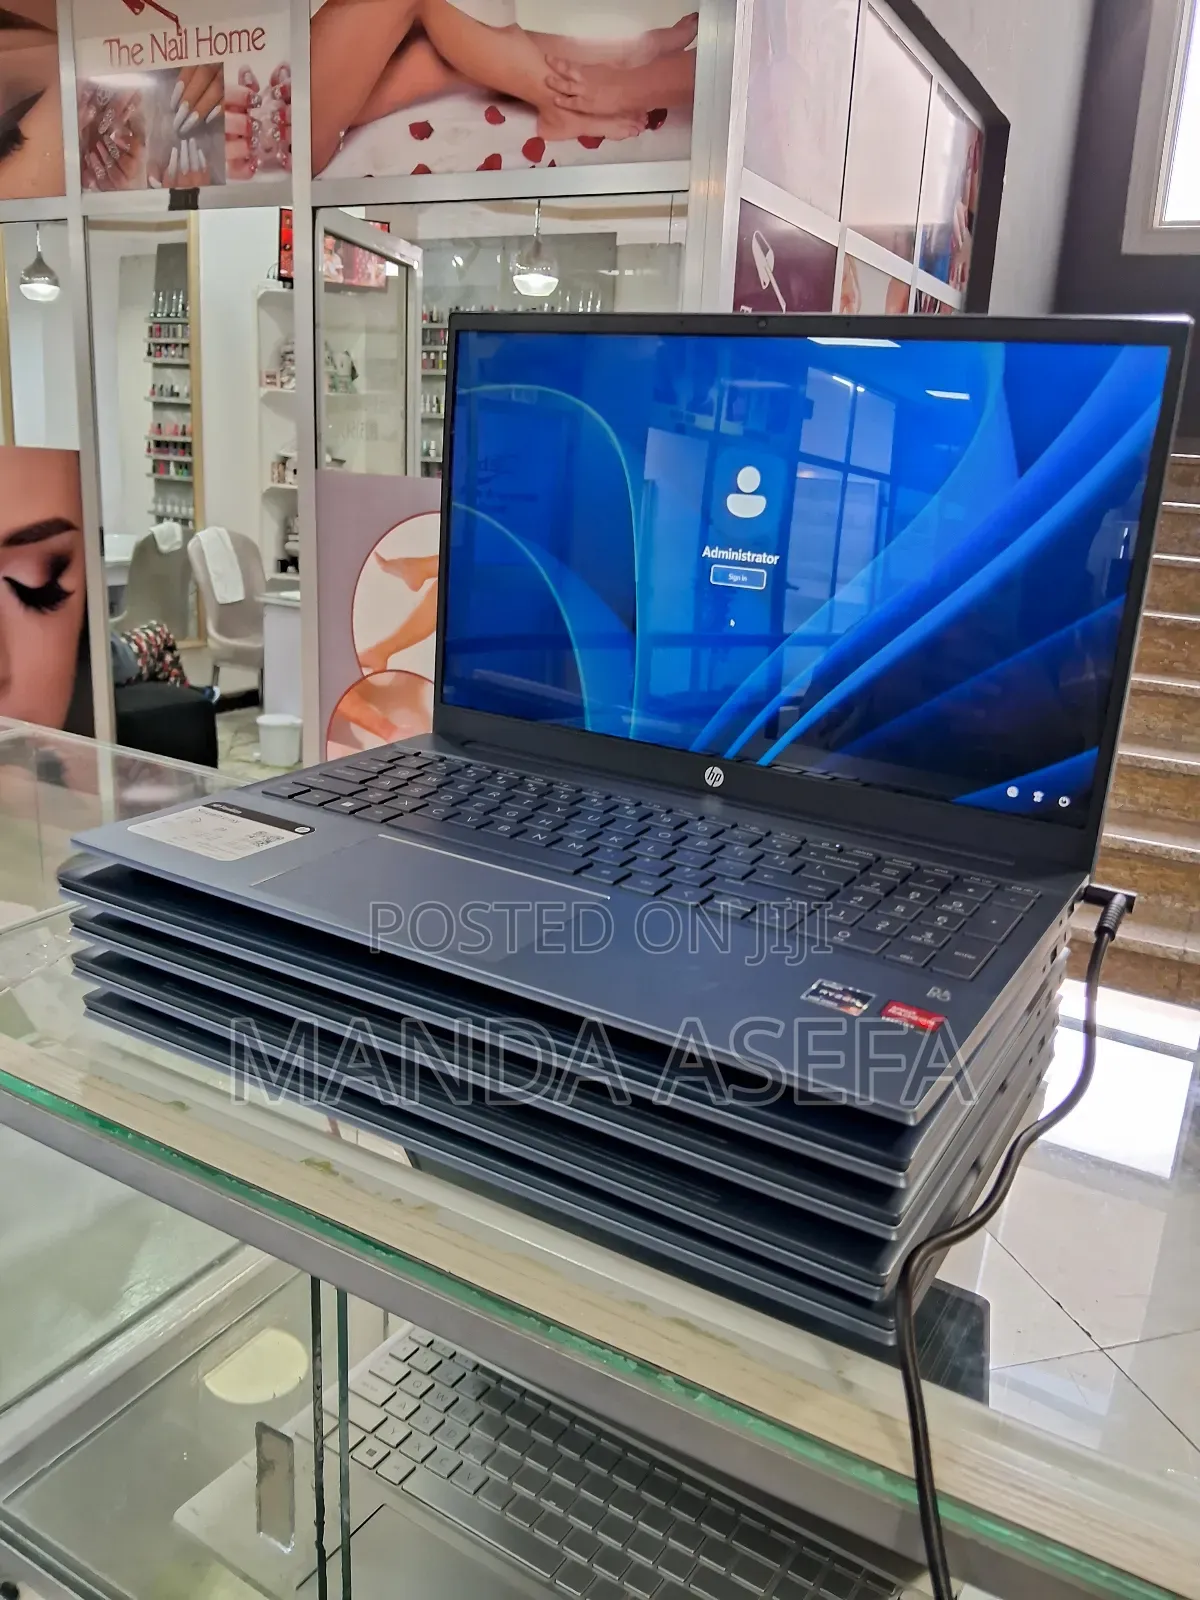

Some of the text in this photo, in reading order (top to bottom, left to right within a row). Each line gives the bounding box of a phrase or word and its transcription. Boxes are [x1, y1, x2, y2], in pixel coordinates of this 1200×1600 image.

[103, 25, 266, 68] The Nail Home
[701, 545, 780, 565] Administrator
[728, 573, 741, 582] Sign
[705, 766, 723, 787] hp
[568, 842, 584, 850] M
